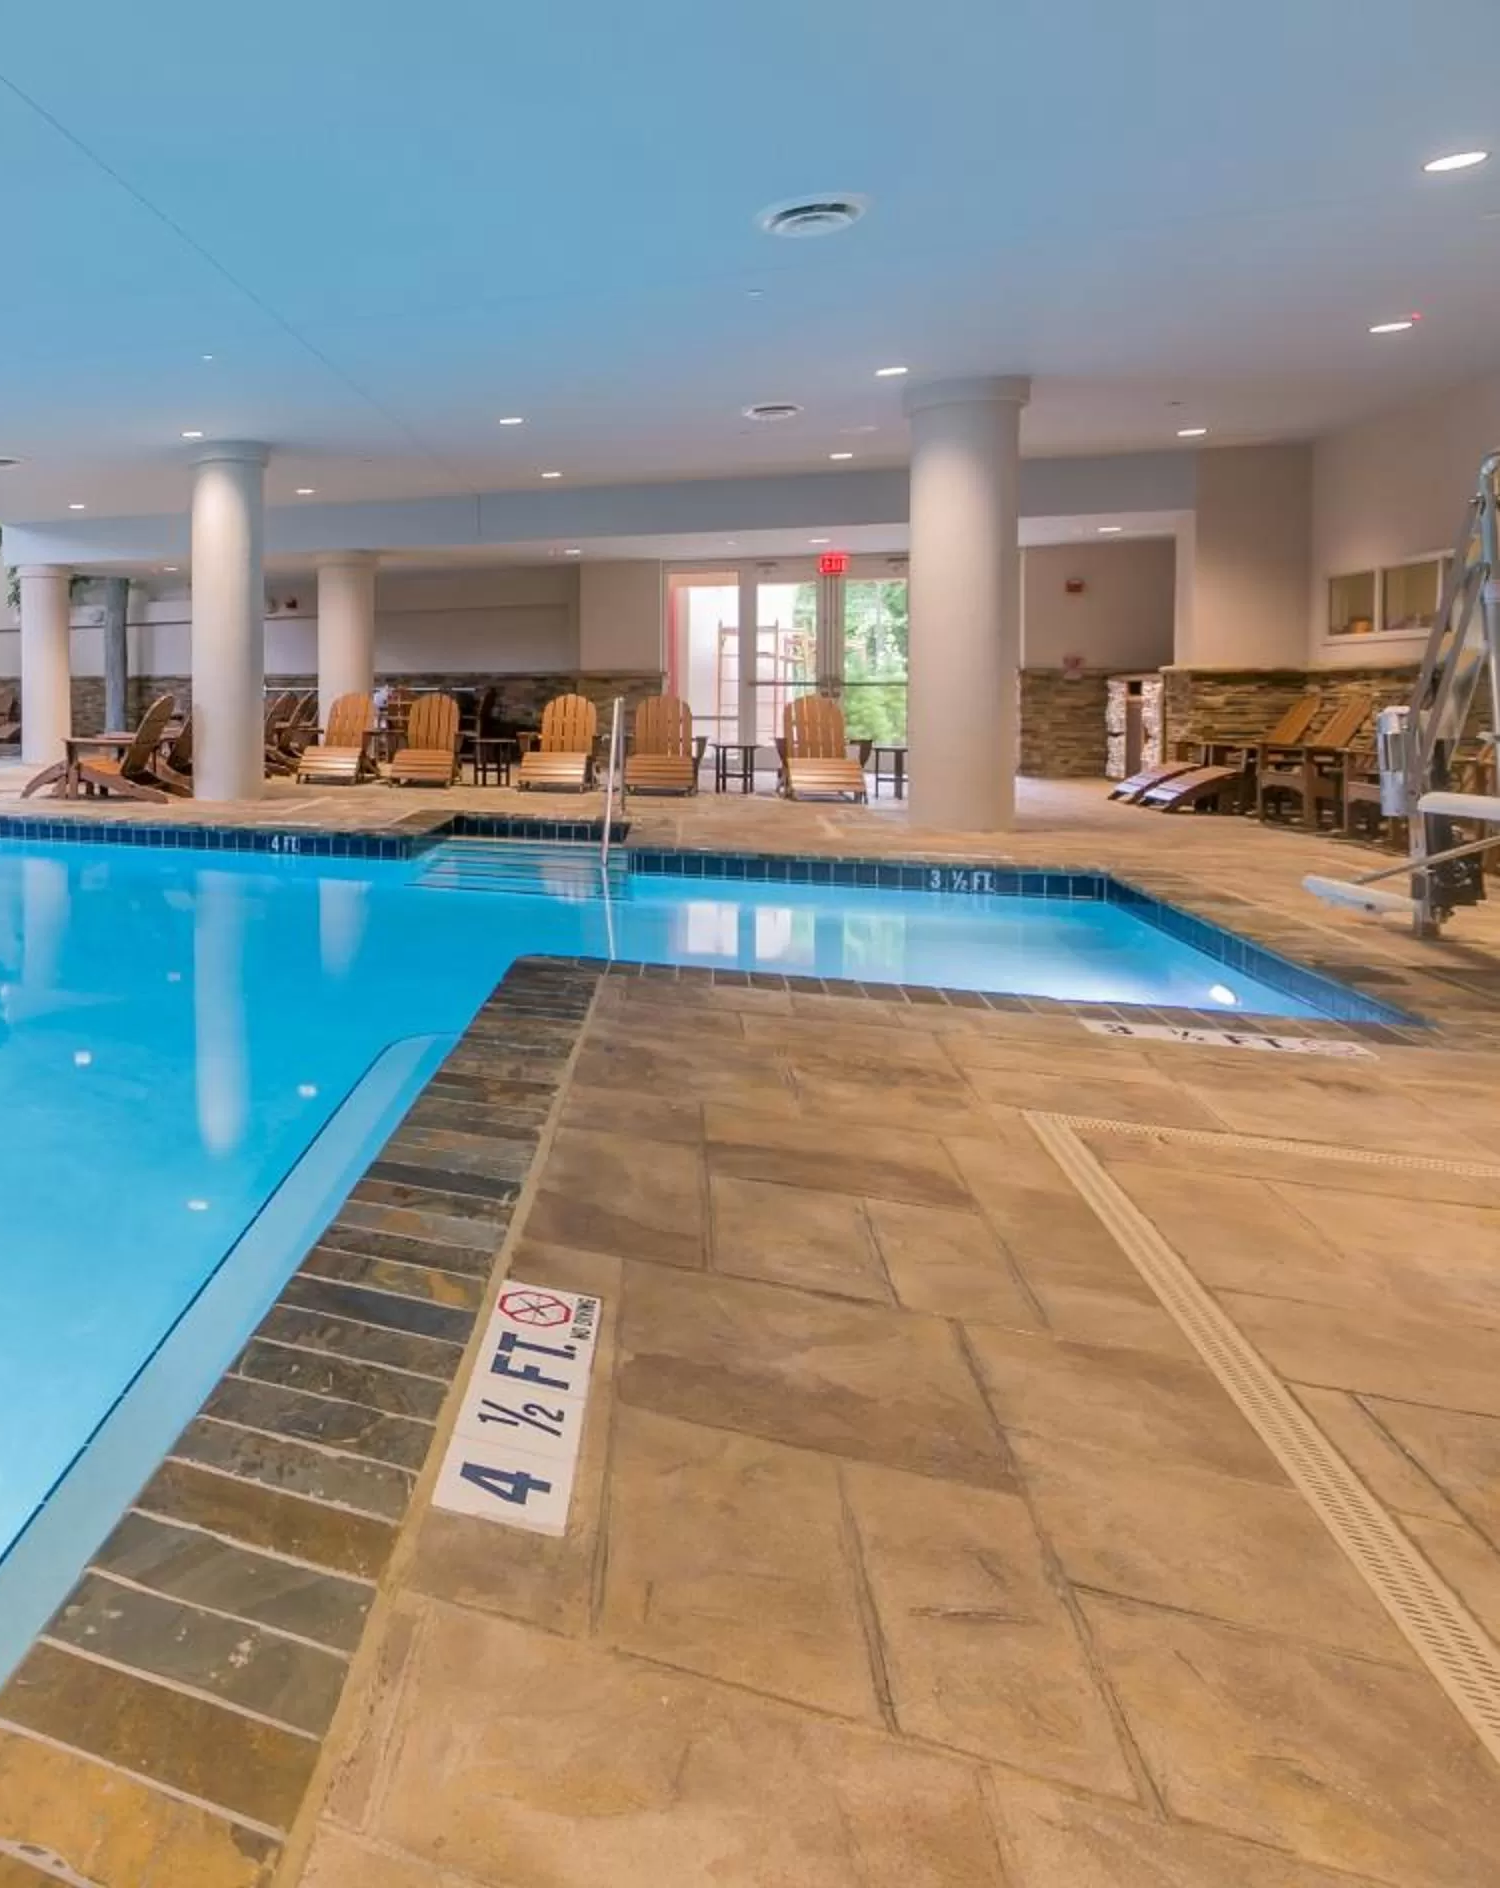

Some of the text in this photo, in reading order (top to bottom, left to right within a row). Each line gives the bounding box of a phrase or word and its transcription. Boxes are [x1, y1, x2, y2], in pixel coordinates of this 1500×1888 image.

[271, 834, 280, 853] 4
[929, 869, 942, 889] 3
[490, 1331, 577, 1391] FT.
[459, 1461, 553, 1506] 4
